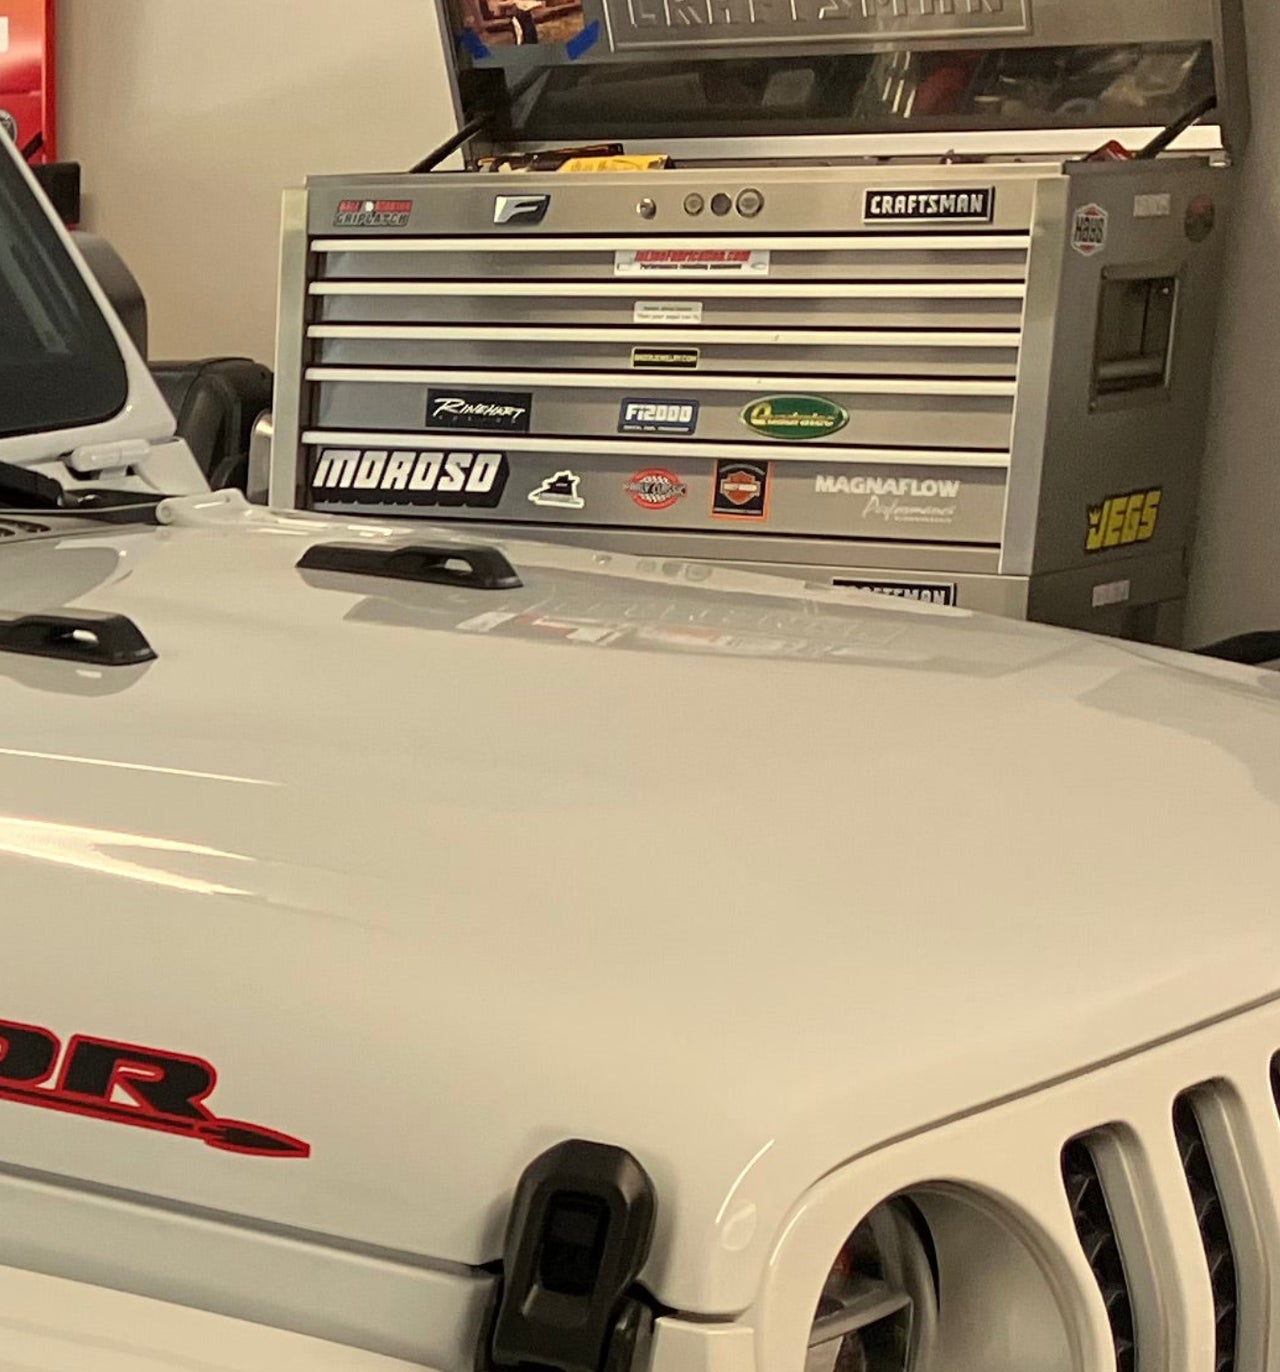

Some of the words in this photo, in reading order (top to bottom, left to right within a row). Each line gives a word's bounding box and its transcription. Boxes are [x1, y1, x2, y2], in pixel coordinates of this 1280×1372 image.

[870, 194, 984, 214] CRAFTSMAN
[312, 450, 503, 493] MOROSO
[815, 475, 960, 498] MAGNAFLOW
[1085, 490, 1162, 550] JEGS
